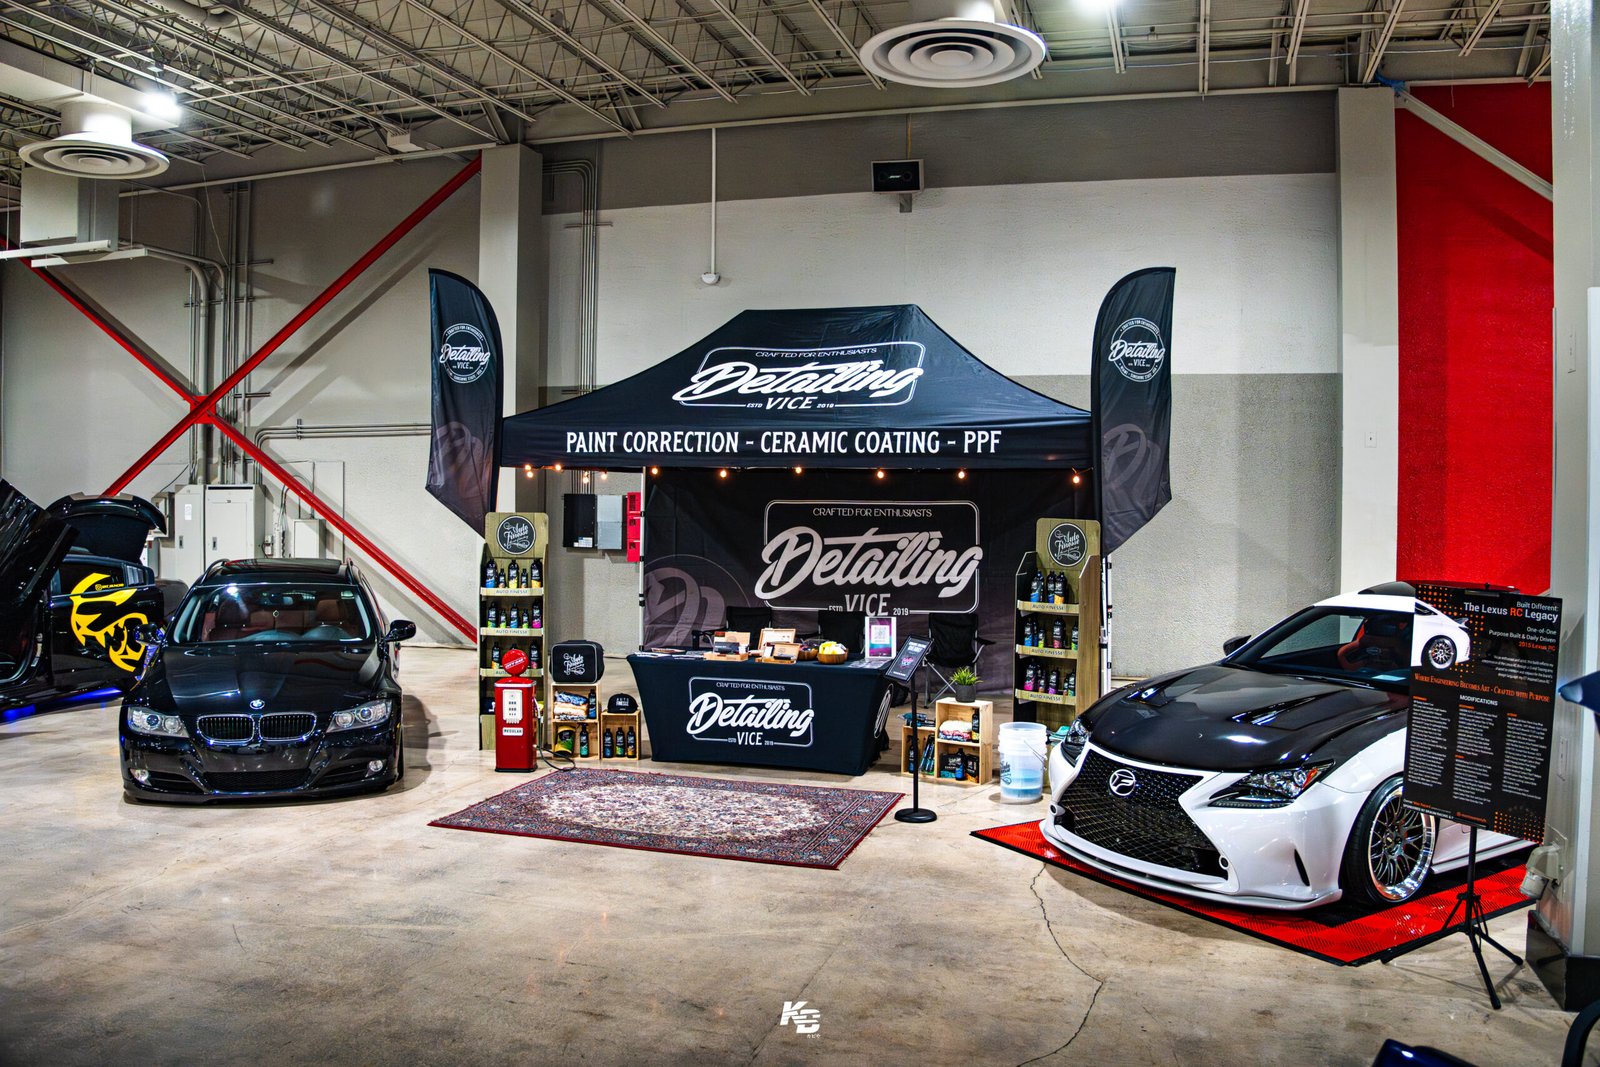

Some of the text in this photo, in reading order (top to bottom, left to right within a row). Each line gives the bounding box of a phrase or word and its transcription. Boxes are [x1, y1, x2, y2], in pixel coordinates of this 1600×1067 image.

[440, 344, 490, 365] Detailing
[818, 348, 877, 357] ENTHUSIASTS
[1108, 340, 1165, 363] Detailing
[672, 360, 924, 401] Detailing
[765, 396, 818, 410] VICE
[566, 432, 617, 453] PAINT
[623, 431, 739, 453] CORRECTION
[760, 431, 848, 453] CERAMIC
[854, 431, 940, 453] COATING
[964, 430, 1002, 453] PPF
[813, 508, 932, 518] CRAFTED FOR ENTHUSIASTS
[755, 526, 983, 600] Detailing
[845, 593, 890, 617] VICE
[1464, 602, 1558, 623] The Lexus RC Legacy
[1531, 603, 1558, 611] Different:
[1527, 626, 1557, 635] One-of-One
[1460, 694, 1498, 706] MODIFICATIONS
[686, 692, 814, 737] Detailing
[737, 732, 763, 745] VICE
